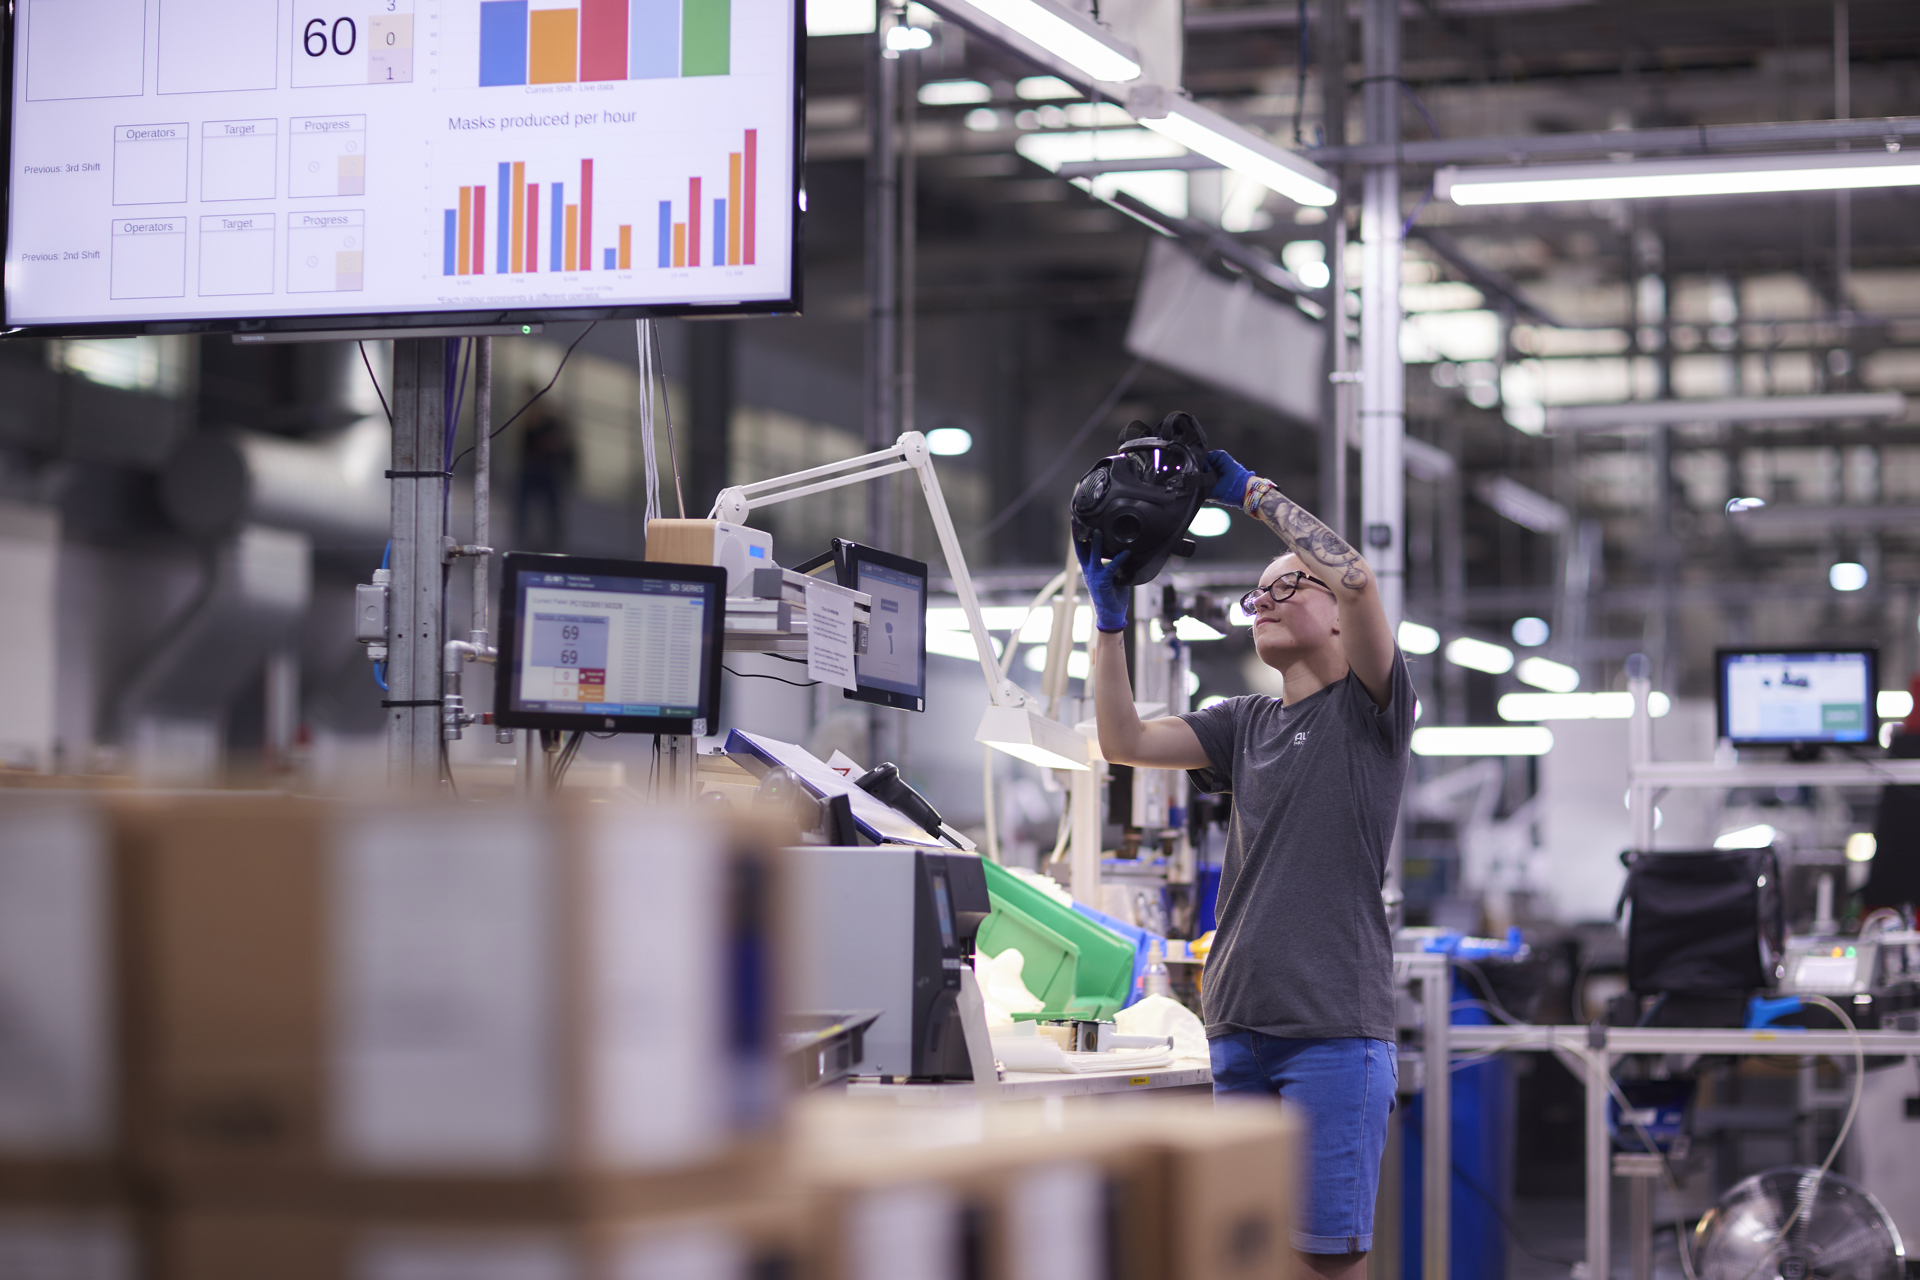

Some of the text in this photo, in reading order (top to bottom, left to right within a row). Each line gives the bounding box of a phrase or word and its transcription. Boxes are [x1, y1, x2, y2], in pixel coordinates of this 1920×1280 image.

[386, 0, 396, 12] 3
[302, 16, 358, 58] 60
[386, 31, 396, 46] 0
[386, 66, 394, 80] 1
[556, 84, 573, 93] Shift
[579, 83, 596, 92] Live
[597, 83, 614, 91] data
[304, 119, 350, 132] Progress
[448, 110, 637, 131] Masks produced per hour
[126, 127, 176, 141] Operators
[224, 123, 255, 136] Target
[24, 162, 101, 174] Previous: 3rd Shift
[222, 218, 253, 230] Target
[302, 214, 348, 227] Progress
[123, 221, 173, 234] Operators
[21, 250, 100, 262] Previous: 2nd Shift
[681, 584, 704, 593] SERIES
[562, 625, 579, 640] 69
[561, 649, 578, 665] 69
